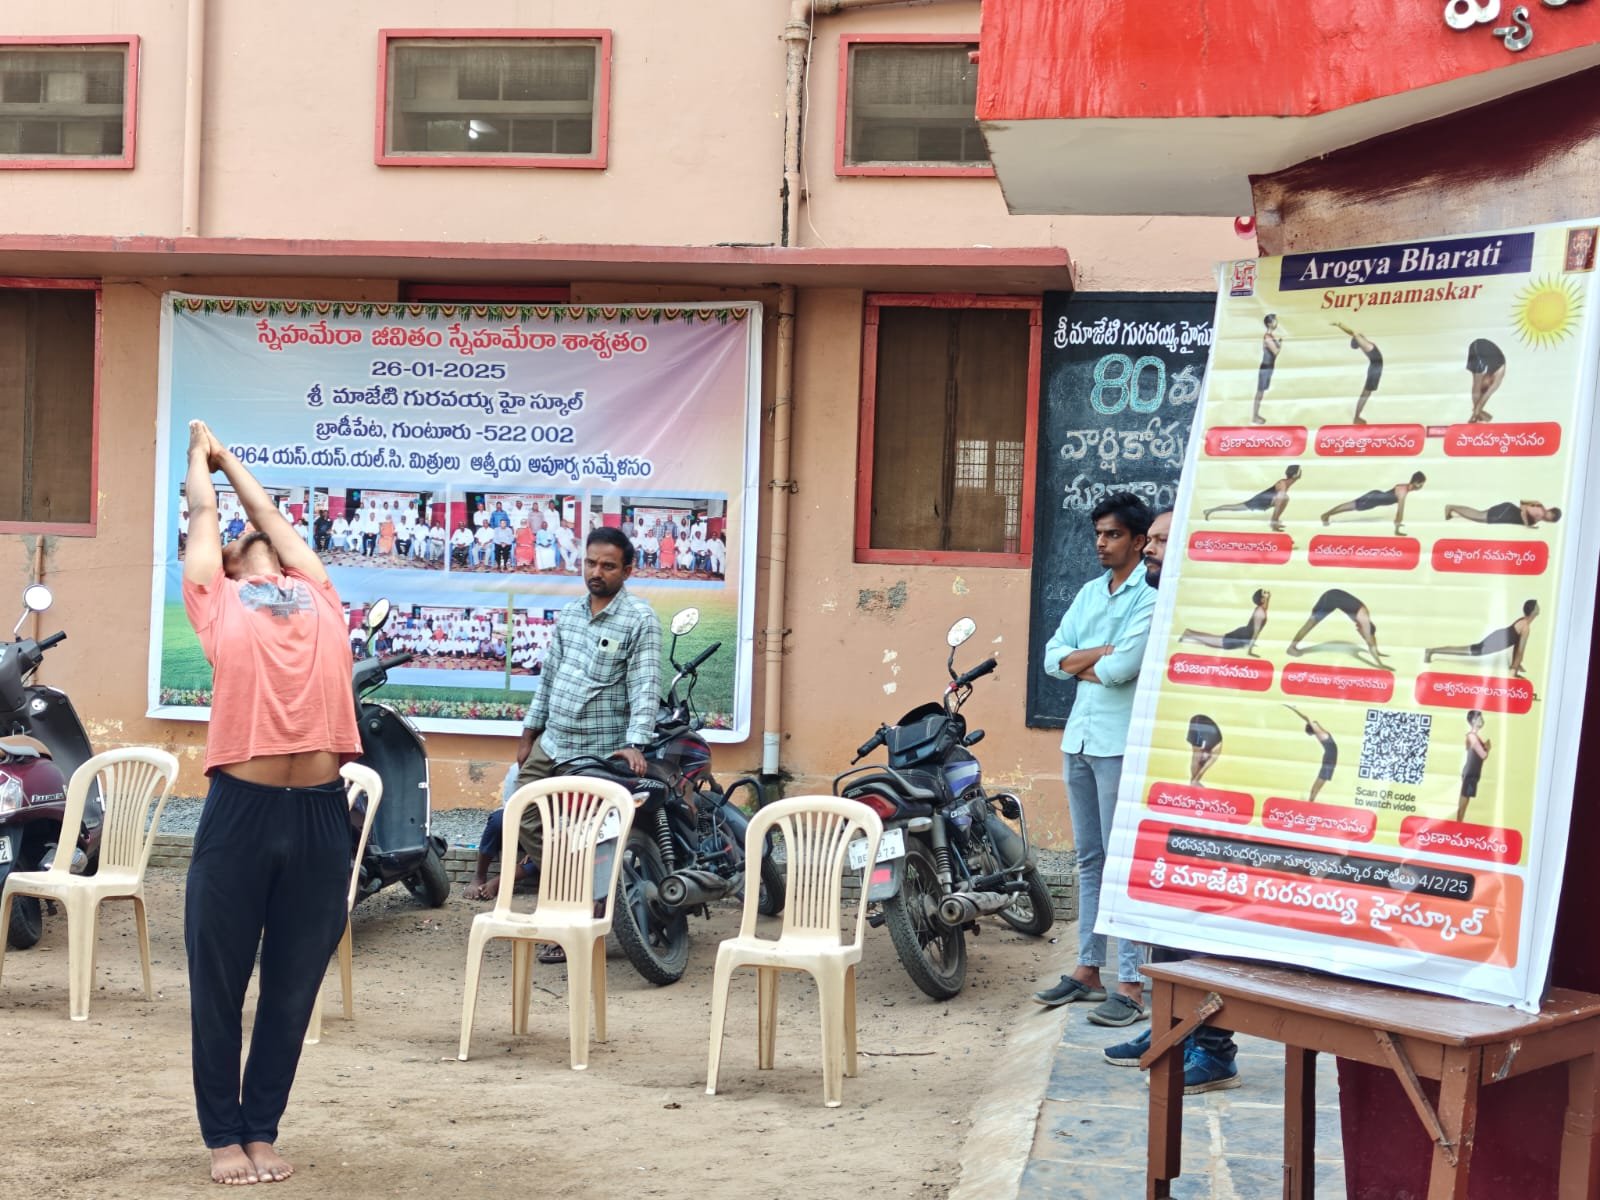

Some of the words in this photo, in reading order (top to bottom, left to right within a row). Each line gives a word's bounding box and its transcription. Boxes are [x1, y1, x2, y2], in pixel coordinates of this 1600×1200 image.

[1299, 248, 1391, 285] Arogya
[1398, 241, 1503, 273] Bharati
[1321, 281, 1483, 313] Suryanamaskar
[256, 318, 363, 351] స్నేహమేరా
[372, 326, 442, 348] జీవితం
[447, 322, 556, 356] స్నేహమేరా
[561, 330, 648, 359] శాశ్వతం
[1054, 316, 1069, 349] శ్రీ
[1069, 317, 1121, 346] మాజేటి
[1121, 321, 1180, 354] గురవయ్య
[371, 360, 506, 379] 26-01-2025
[307, 384, 324, 408] శ్రీ
[332, 387, 399, 407] మాజేటి
[403, 389, 494, 415] గురవయ్య
[498, 391, 526, 415] హై
[529, 391, 585, 417] స్కూల్
[316, 414, 387, 441] బ్రాడీపేట,
[391, 420, 472, 441] గుంటూరు
[531, 425, 575, 444] 002
[1219, 435, 1292, 452] ప్రణామాసనం
[409, 452, 461, 476] మిత్రులు
[470, 451, 522, 479] ఆత్మీయ
[528, 454, 581, 481] అపూర్వ
[582, 452, 653, 482] సమ్మేళనం
[1482, 550, 1537, 566] నమస్కారం
[1173, 660, 1259, 680] భుజంగాసనము
[1433, 680, 1529, 700] అశ్వసంచాలనాసనం
[1355, 786, 1378, 798] Scan
[1379, 789, 1393, 800] QR
[1394, 792, 1416, 802] code
[1355, 796, 1364, 806] to
[1365, 798, 1392, 809] watch
[1393, 802, 1416, 813] video
[1416, 827, 1508, 854] ప్రణామాసనం
[1283, 855, 1372, 883] సూర్యనమస్కార
[1373, 866, 1416, 886] పోటీలు
[1418, 874, 1469, 895] 4/2/25
[1149, 856, 1168, 889] శ్రీ
[1170, 865, 1249, 897] మాజేటి
[1253, 877, 1359, 925] గురవయ్య
[1369, 895, 1489, 942] హైస్కూల్
